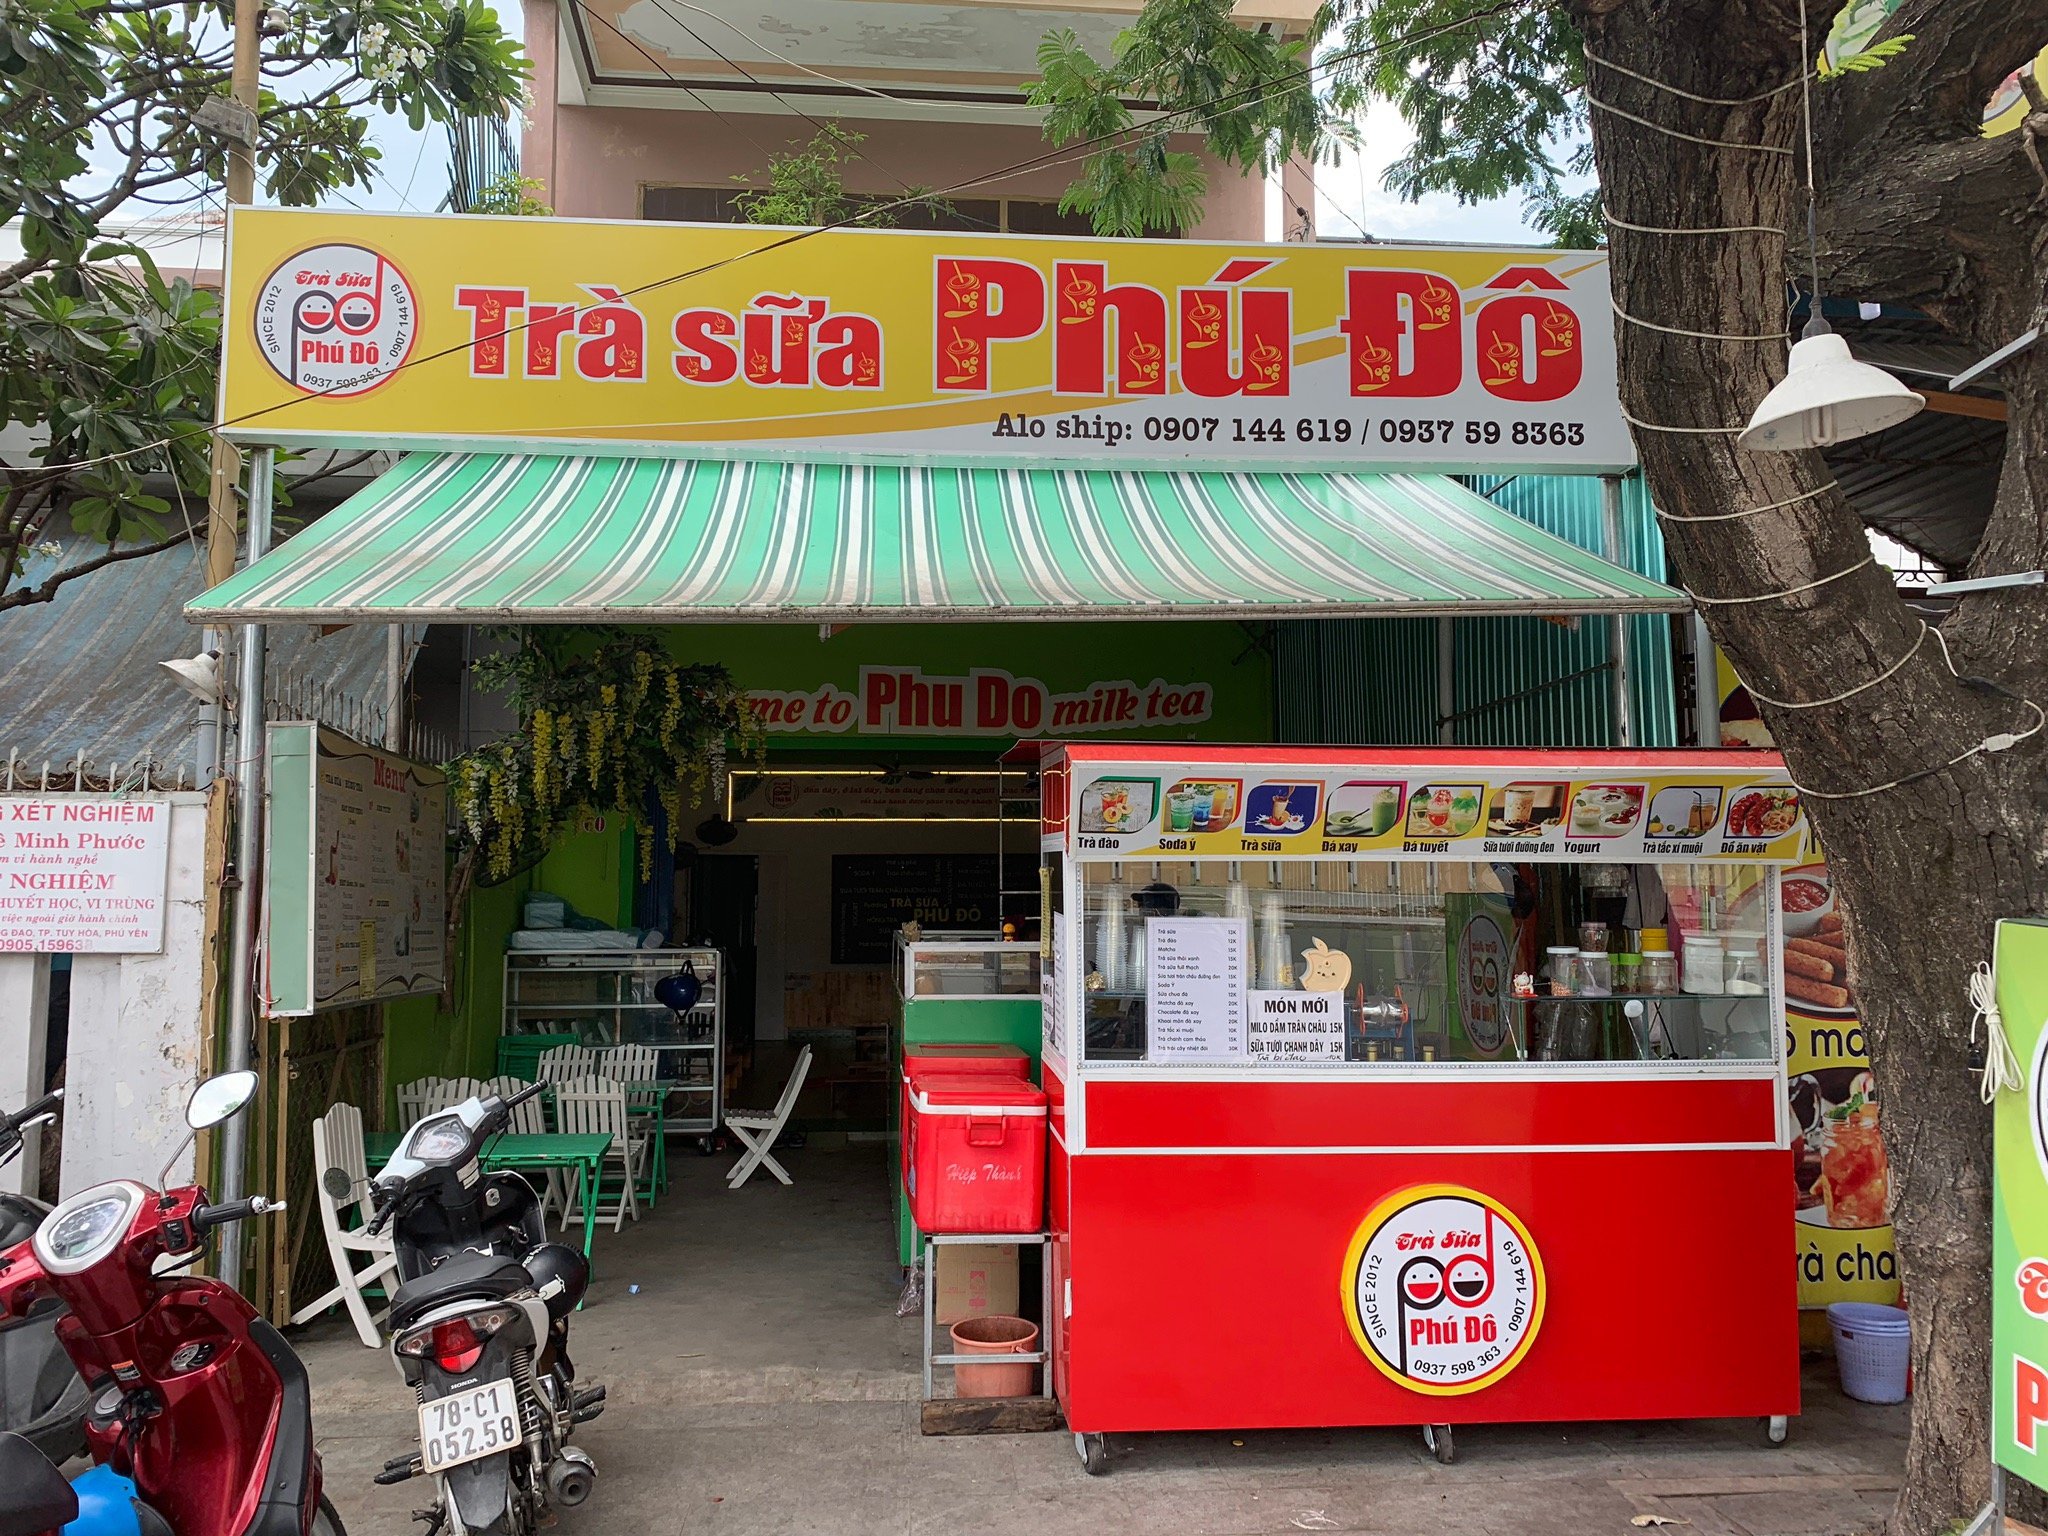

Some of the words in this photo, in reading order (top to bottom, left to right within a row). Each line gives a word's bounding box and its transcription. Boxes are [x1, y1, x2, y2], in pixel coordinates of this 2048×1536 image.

[295, 270, 331, 286] Trà
[335, 272, 373, 288] Sữa
[264, 285, 282, 313] 2012
[390, 284, 406, 305] 619
[398, 306, 409, 326] 144
[263, 317, 280, 354] SINCE
[458, 285, 645, 378] Trà
[675, 293, 881, 387] sữa
[936, 258, 1290, 396] Phú
[1341, 266, 1583, 401] Đô
[301, 340, 344, 364] Phú
[350, 341, 379, 365] Đô
[389, 330, 407, 358] 0907
[303, 373, 332, 388] 0937
[992, 413, 1046, 438] Alo
[1056, 414, 1132, 446] ship:
[1143, 416, 1220, 442] 0907
[1232, 418, 1286, 442] 144
[1296, 418, 1352, 443] 619
[1379, 418, 1454, 444] 0937
[1465, 421, 1501, 445] 59
[1511, 421, 1585, 446] 8363
[813, 692, 851, 725] to
[866, 673, 963, 727] Phu
[977, 675, 1042, 729] Do
[1052, 687, 1139, 727] milk
[1147, 685, 1206, 721] tea
[373, 757, 406, 793] Menu
[11, 800, 56, 822] XÉT
[63, 801, 154, 826] NGHIỆM
[14, 832, 69, 849] Minh
[77, 832, 145, 850] Phước
[1078, 836, 1096, 849] Trà
[1098, 837, 1120, 849] đào
[1159, 838, 1187, 850] Soda
[1241, 839, 1259, 851] Trà
[1261, 839, 1282, 852] sữa
[1321, 840, 1336, 852] Đá
[1338, 841, 1358, 853] xay
[1402, 841, 1417, 852] Đá
[1419, 841, 1449, 854] tuyết
[1483, 841, 1498, 853] Sữa
[1499, 841, 1514, 853] tươi
[1515, 841, 1539, 854] đường
[1540, 841, 1554, 853] đen
[1564, 842, 1600, 854] Yogurt
[1642, 842, 1656, 854] Trà
[1657, 842, 1671, 854] tắc
[1682, 843, 1703, 856] muội
[1721, 840, 1734, 853] Đồ
[1735, 842, 1749, 853] ăn
[1751, 842, 1767, 856] vặt
[30, 853, 63, 864] hành
[9, 870, 117, 893] NGHIỆM
[87, 898, 102, 910] VI
[105, 896, 155, 910] TRÙNG
[56, 929, 75, 938] TUY
[1264, 996, 1297, 1013] MÓN
[1301, 996, 1328, 1013] MỚI
[1250, 1022, 1268, 1033] MILO
[1287, 1019, 1306, 1033] TRÂN
[1308, 1019, 1327, 1033] CHÂU
[1330, 1022, 1343, 1033] 15K
[1250, 1038, 1264, 1053] SỮA
[1284, 1041, 1307, 1053] CHANH
[1310, 1039, 1324, 1053] DÂY
[1330, 1041, 1343, 1053] 15K
[1395, 1229, 1435, 1251] Trà
[1441, 1230, 1482, 1249] Sữa
[1503, 1240, 1522, 1265] 619
[1365, 1254, 1383, 1289] 2012
[1515, 1267, 1527, 1293] 144
[1365, 1292, 1388, 1340] SINCE
[1508, 1298, 1527, 1333] 0907
[1410, 1315, 1458, 1346] Phú
[1464, 1313, 1497, 1342] Đô
[1477, 1345, 1501, 1367] 363
[1413, 1358, 1447, 1376] 0937
[1451, 1360, 1476, 1376] 598
[450, 1378, 478, 1390] HONDA
[433, 1387, 500, 1432] 78-C1
[428, 1415, 515, 1466] 052.58
